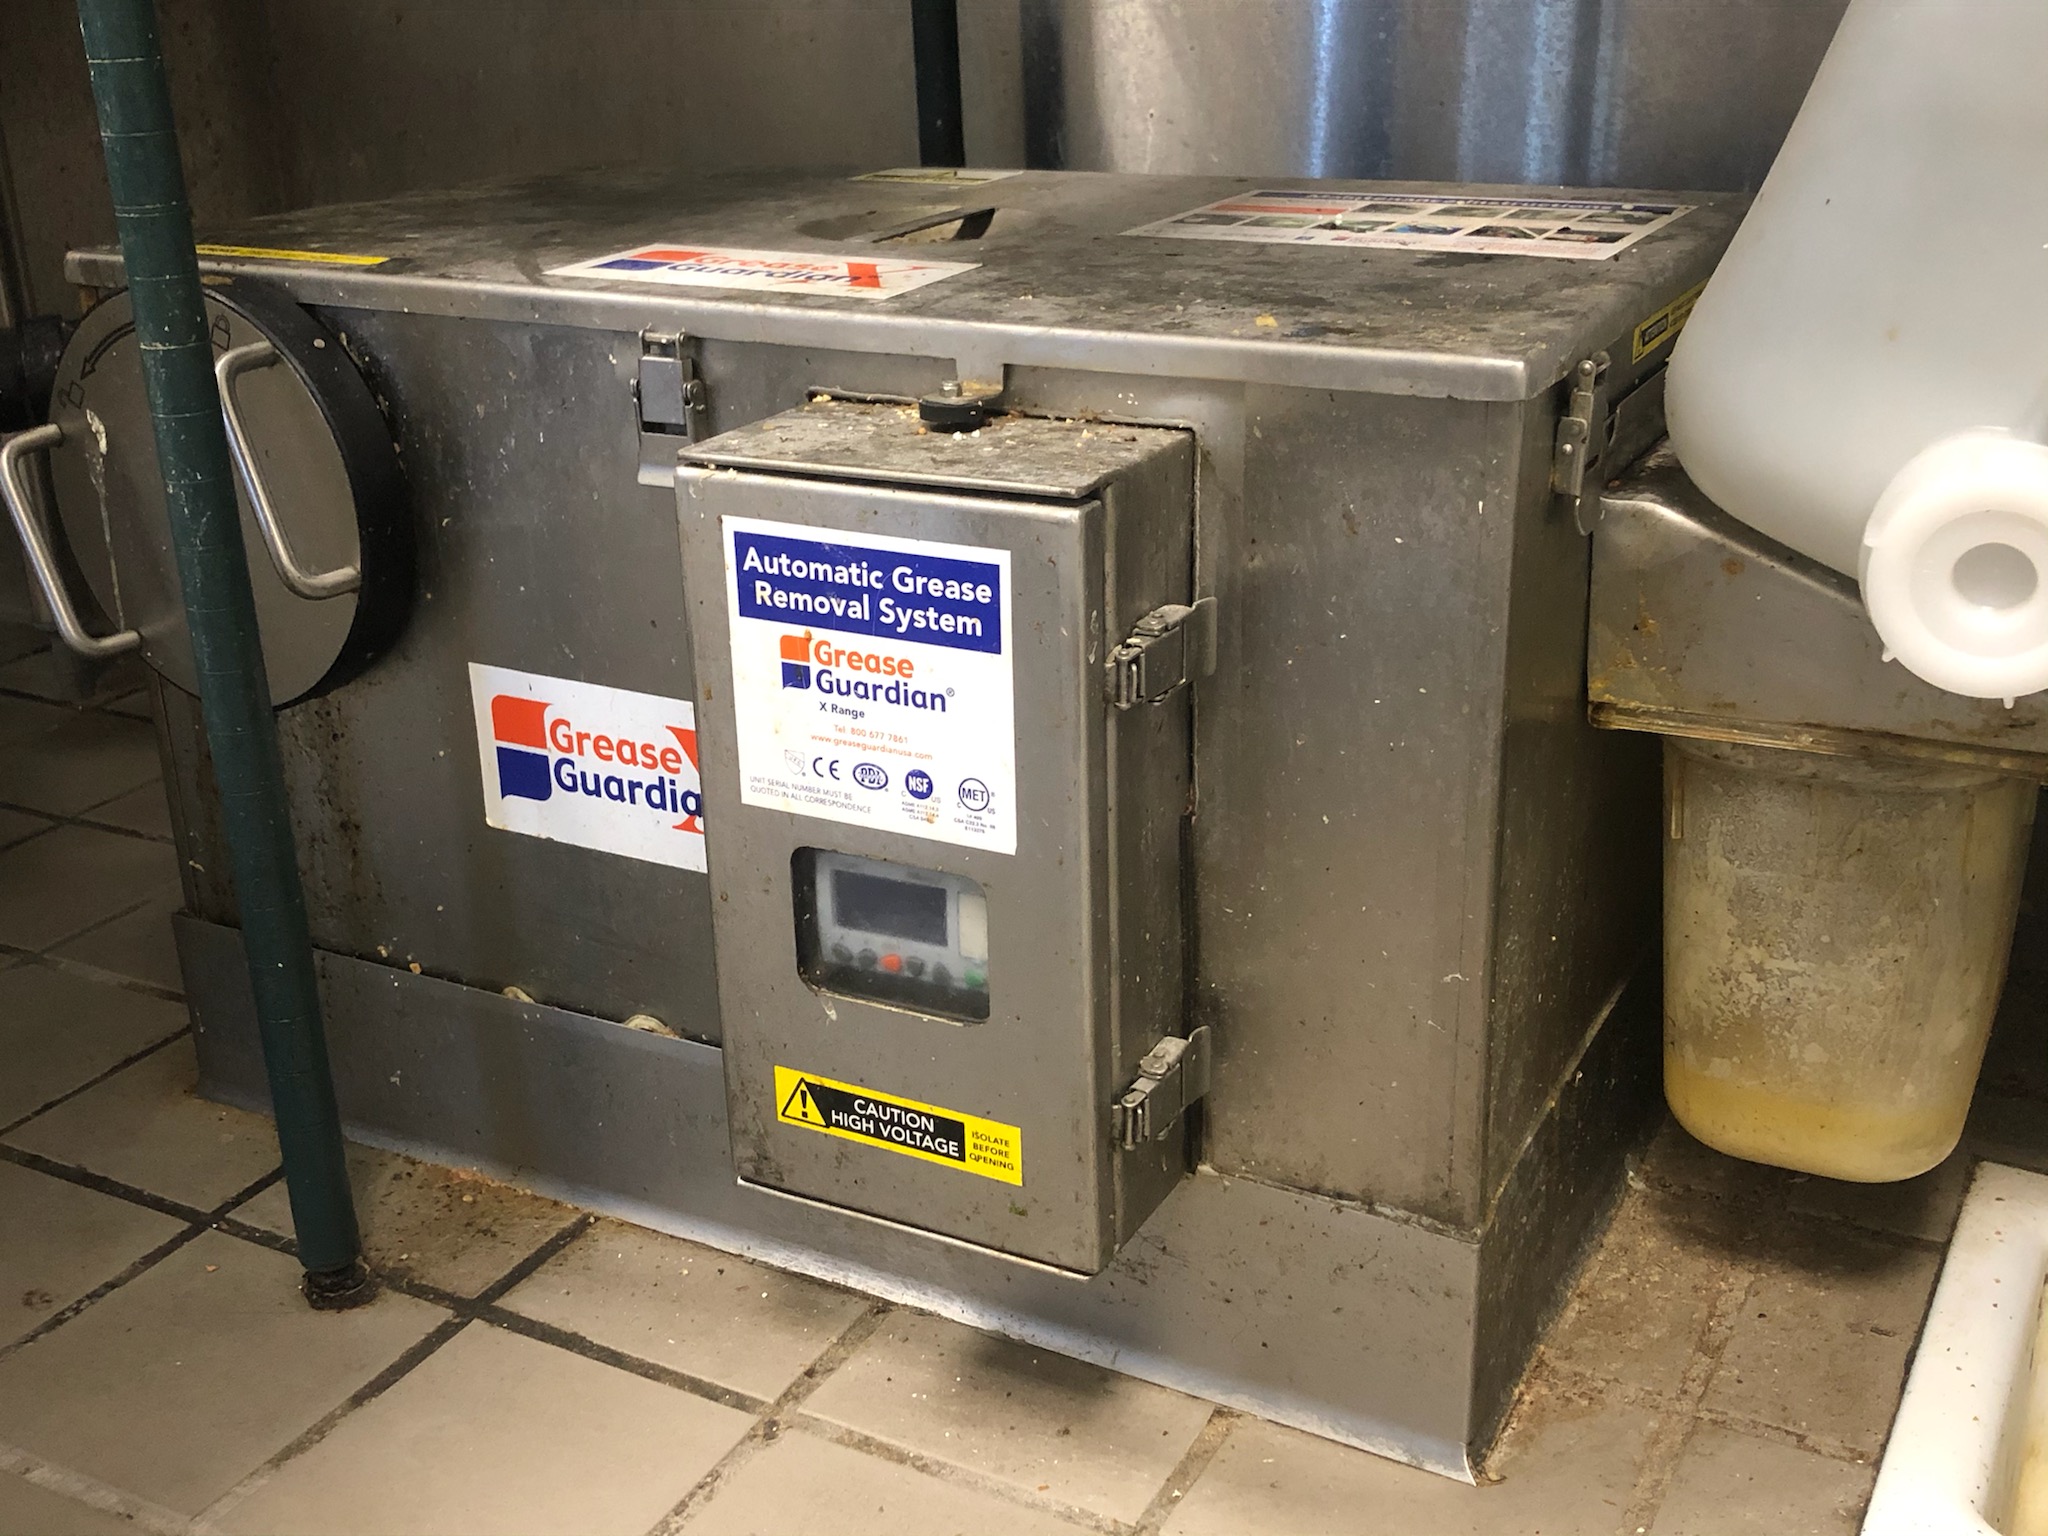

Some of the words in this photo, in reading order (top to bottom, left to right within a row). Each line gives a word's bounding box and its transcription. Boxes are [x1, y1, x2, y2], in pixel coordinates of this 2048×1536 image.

[668, 262, 862, 283] Guardian
[694, 256, 838, 272] Grease
[742, 546, 884, 589] Automatic
[891, 565, 993, 604] Grease
[755, 581, 870, 621] Removal
[879, 597, 982, 637] System
[814, 640, 914, 678] Grease
[819, 701, 828, 712] X
[831, 703, 865, 720] Range
[549, 718, 682, 775] Grease
[850, 727, 866, 737] 800
[869, 730, 885, 740] 677
[888, 733, 908, 744] 7861
[813, 757, 840, 781] CE
[553, 757, 702, 818] Guardia
[750, 776, 766, 784] UNIT
[767, 778, 790, 789] SERIAL
[792, 783, 821, 795] NUMBER
[823, 789, 842, 798] MUST
[844, 792, 853, 801] BE
[908, 775, 930, 793] NSF
[962, 787, 986, 802] MET
[750, 785, 780, 797] QUOTED
[791, 792, 803, 801] ALL
[804, 795, 871, 814] CORRESPONDENCE
[853, 1099, 935, 1133] CAUTION
[831, 1110, 875, 1134] HIGH
[879, 1122, 960, 1157] VOLTAGE
[972, 1131, 1010, 1148] ISOLATE
[969, 1153, 1015, 1171] OPENING
[972, 1142, 1010, 1159] BEFORE
